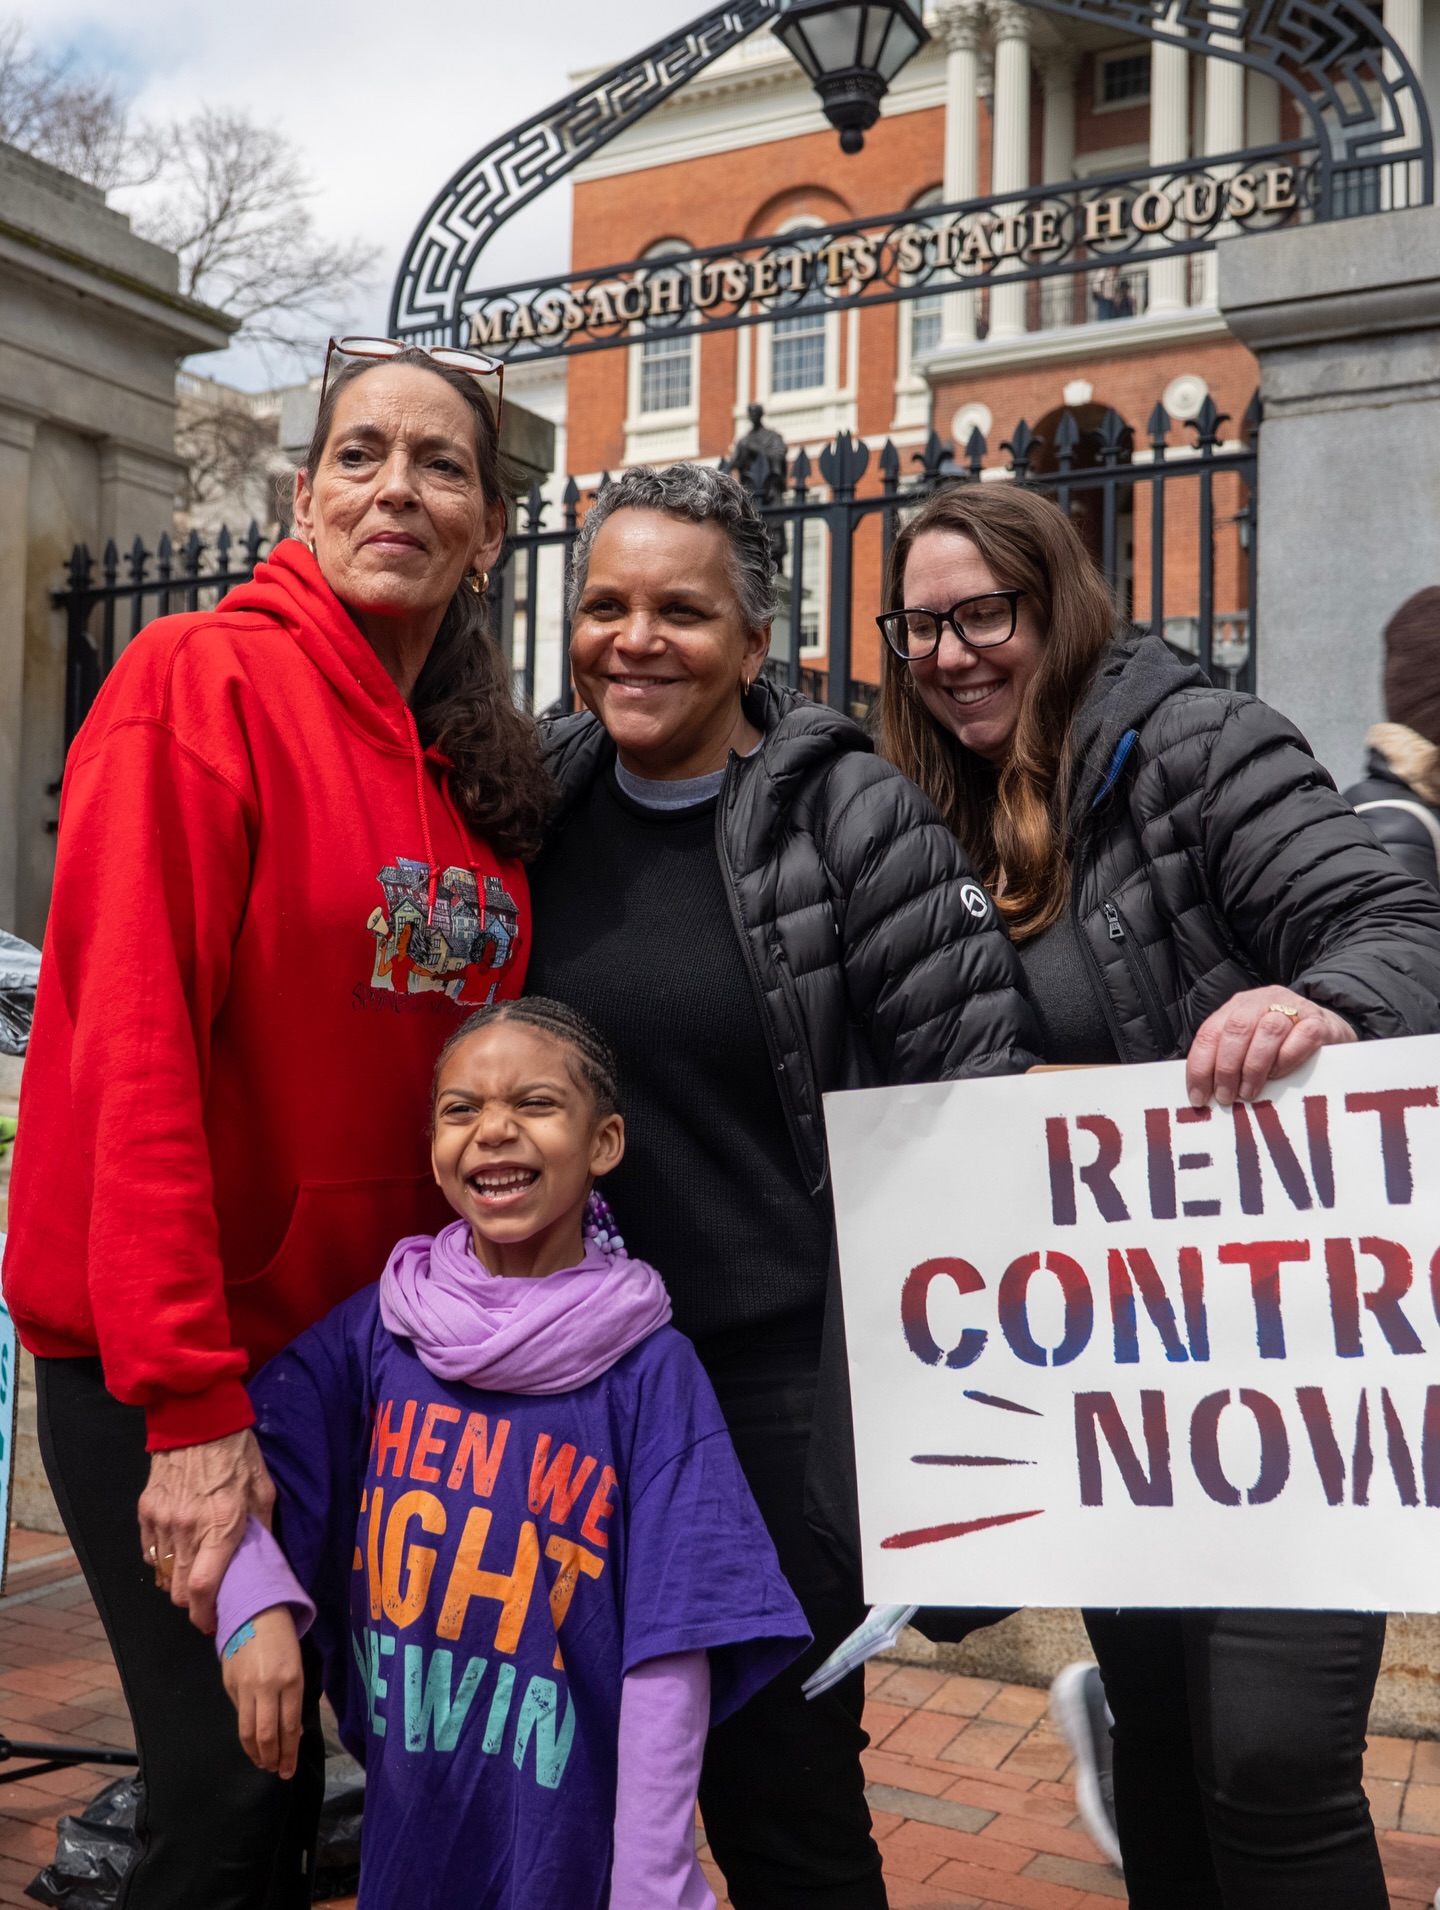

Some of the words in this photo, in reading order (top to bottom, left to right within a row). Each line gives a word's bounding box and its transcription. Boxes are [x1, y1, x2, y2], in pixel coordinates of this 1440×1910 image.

[469, 240, 879, 346] MASSACHUSETTS
[898, 208, 1062, 273] STATE
[1084, 166, 1299, 242] HOUSE
[1045, 1086, 1439, 1226] RENT
[900, 1236, 1440, 1369] CONTR
[371, 1399, 511, 1497] HEN
[528, 1432, 618, 1549] WE
[1073, 1384, 1440, 1507] NOW
[352, 1487, 605, 1670] IGHT
